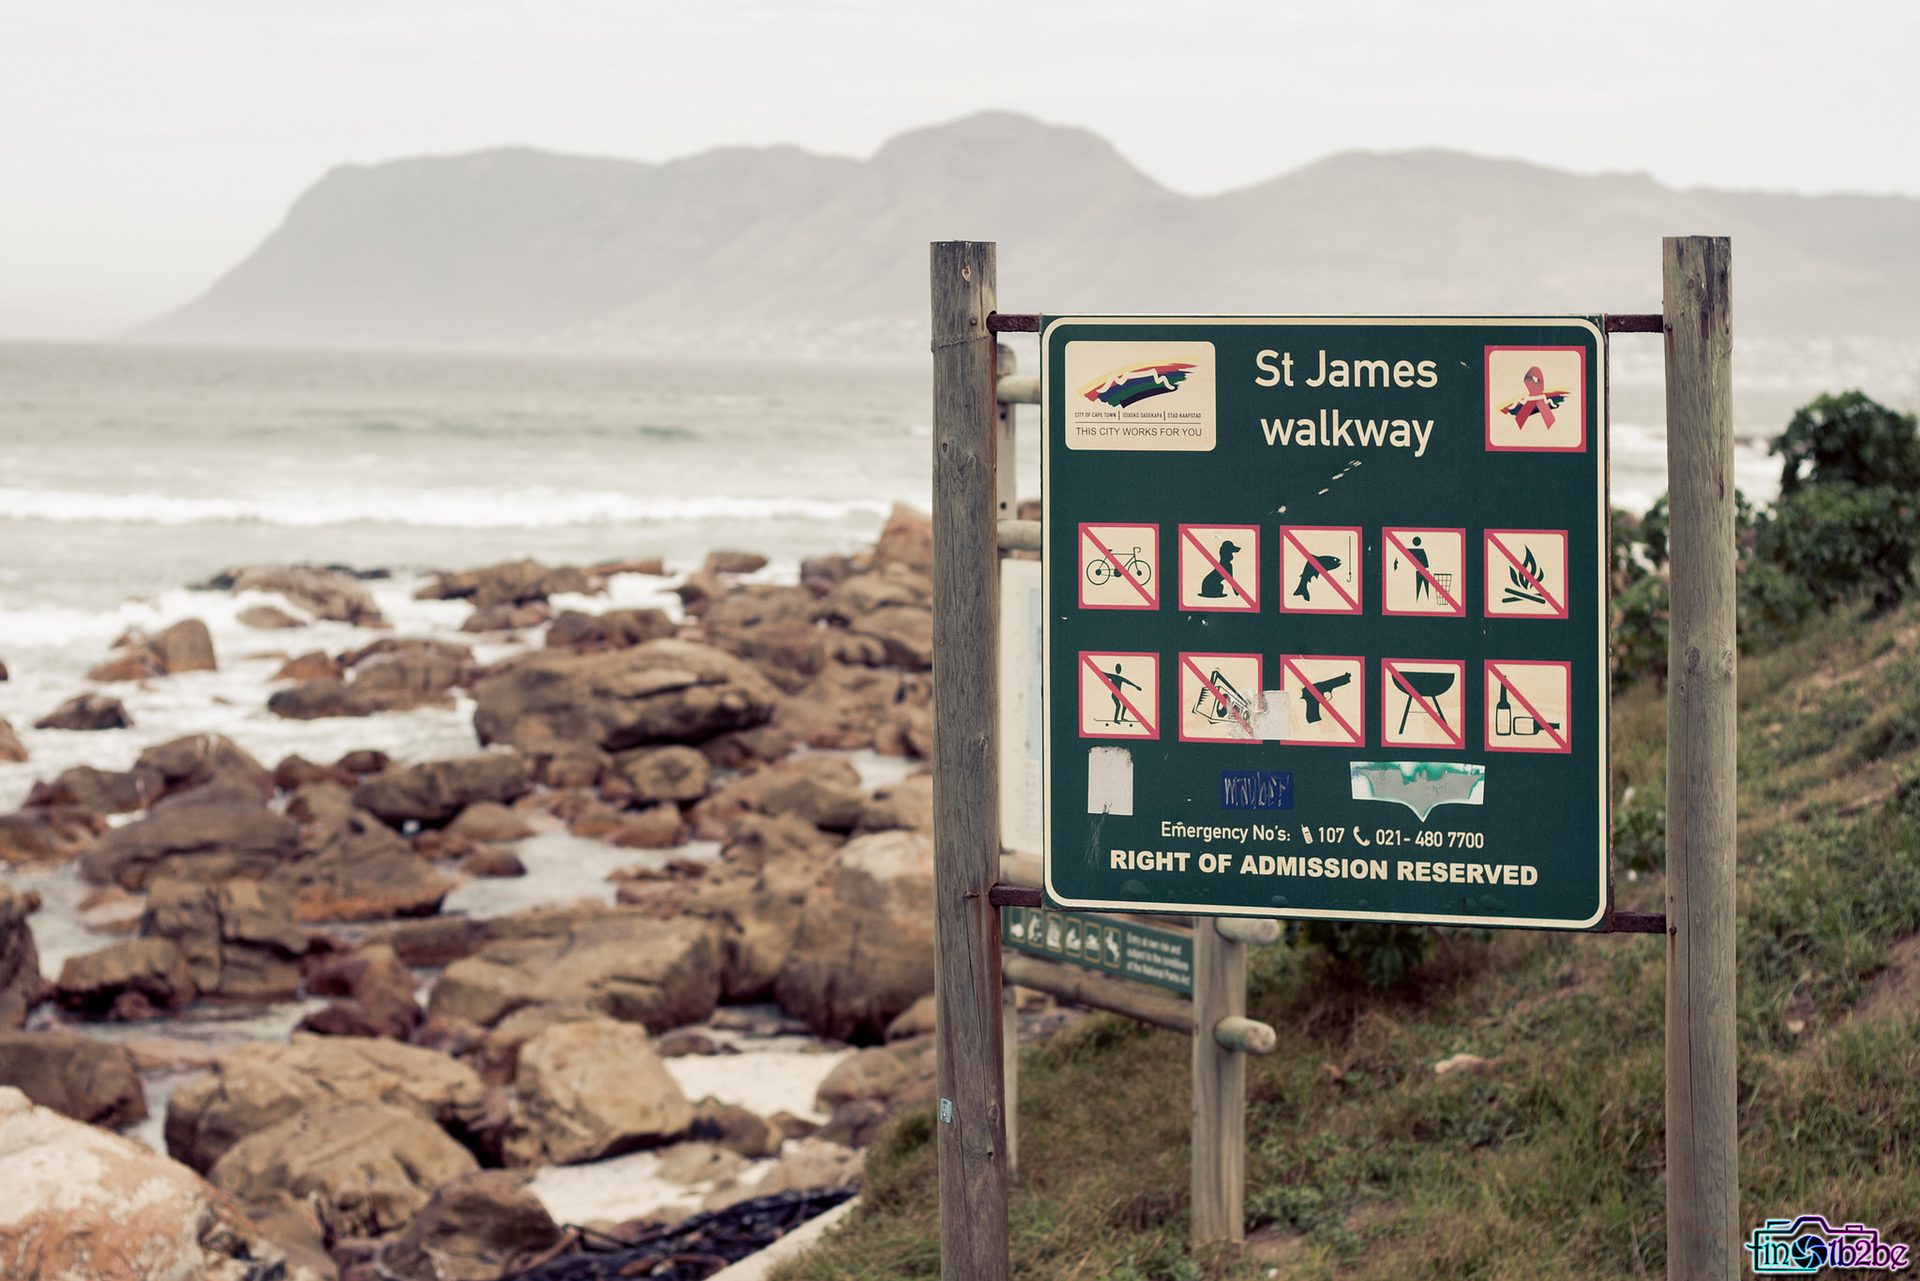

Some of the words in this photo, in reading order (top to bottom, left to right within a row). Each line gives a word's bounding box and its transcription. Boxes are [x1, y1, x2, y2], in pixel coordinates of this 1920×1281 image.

[1255, 349, 1294, 387] St
[1305, 350, 1438, 388] James
[1076, 427, 1097, 436] THIS
[1099, 427, 1120, 436] CITY
[1122, 427, 1157, 436] WORKS
[1160, 427, 1180, 437] FOR
[1181, 428, 1202, 437] YOU
[1260, 409, 1435, 457] walkway
[1161, 821, 1248, 844] Emergency
[1319, 826, 1345, 844] 107
[1415, 830, 1443, 847] 480
[1447, 831, 1485, 849] 7700
[1110, 849, 1191, 872] RIGHT
[1198, 852, 1233, 873] OF
[1239, 854, 1388, 880] ADMISSION
[1397, 860, 1539, 886] RESERVED
